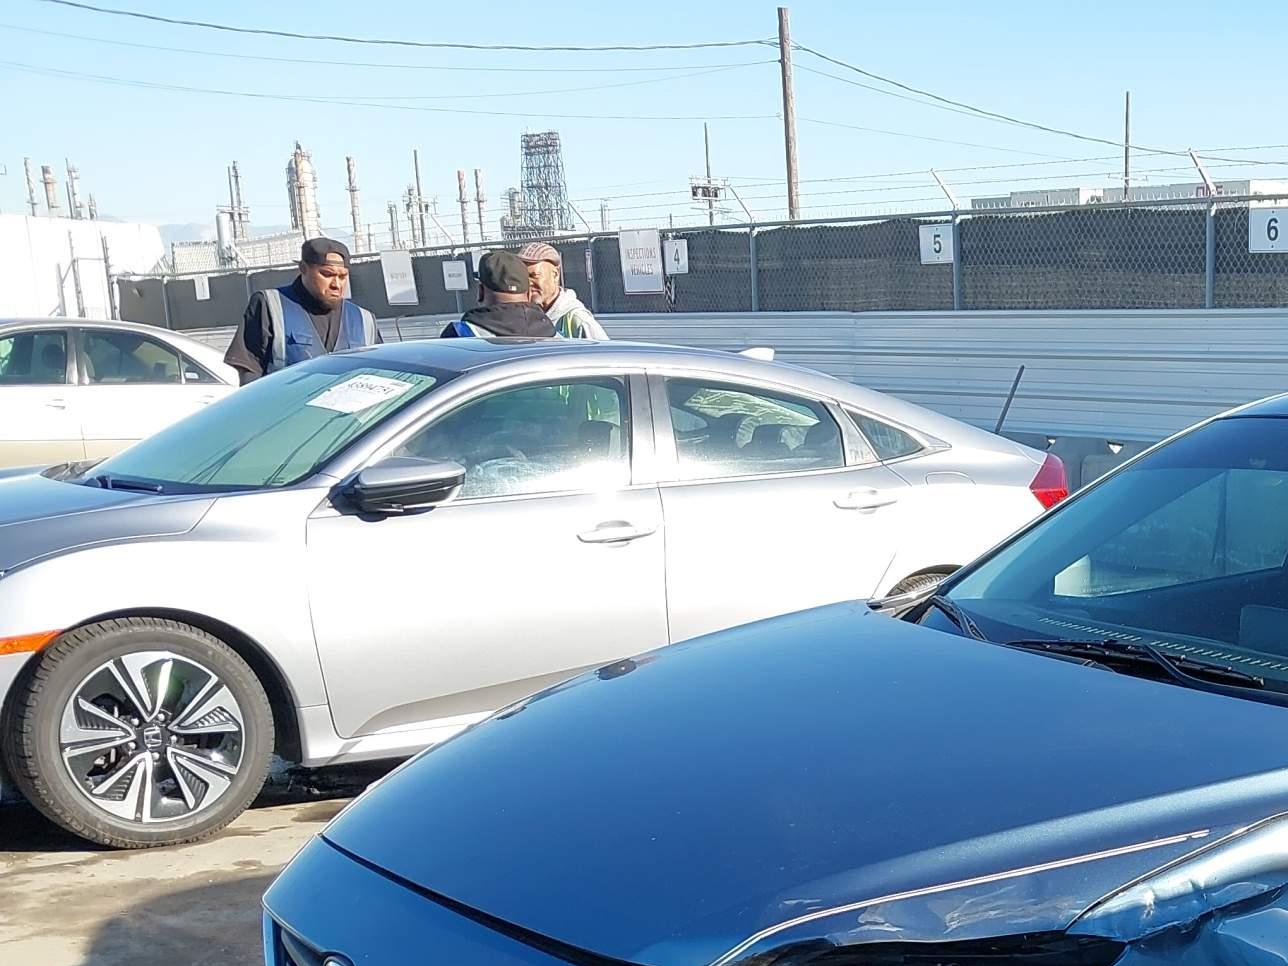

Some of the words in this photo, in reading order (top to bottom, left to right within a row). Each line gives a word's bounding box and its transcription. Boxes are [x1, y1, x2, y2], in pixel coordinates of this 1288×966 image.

[1266, 217, 1279, 241] 6
[933, 234, 942, 254] 5
[673, 248, 681, 265] 4
